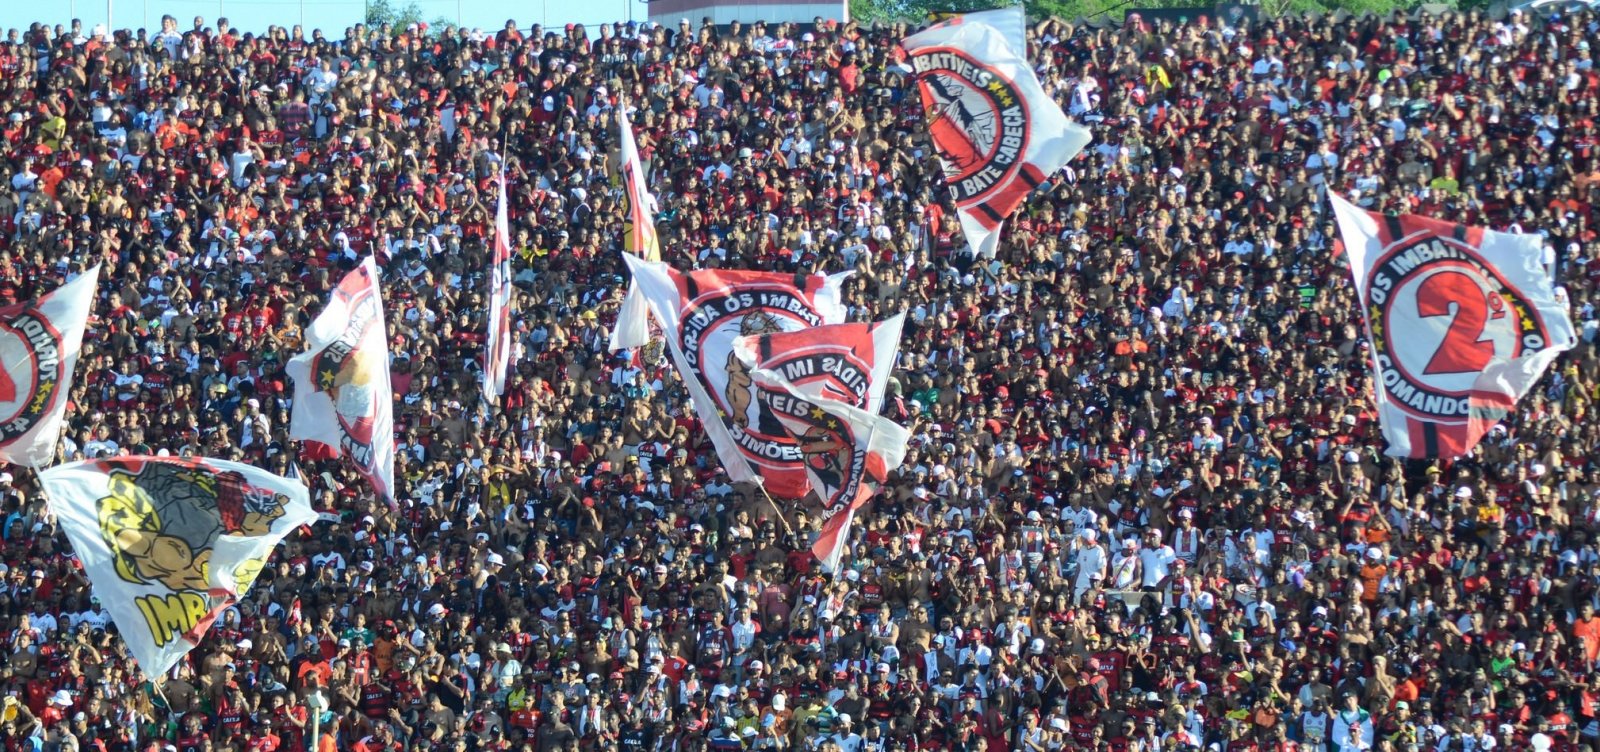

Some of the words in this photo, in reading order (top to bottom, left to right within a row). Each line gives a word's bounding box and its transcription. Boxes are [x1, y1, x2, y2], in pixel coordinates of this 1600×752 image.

[961, 165, 1003, 198] BATE
[996, 105, 1023, 164] CABEÇA
[1370, 272, 1392, 305] OS
[723, 293, 754, 313] OS
[222, 716, 241, 724] CAIXA
